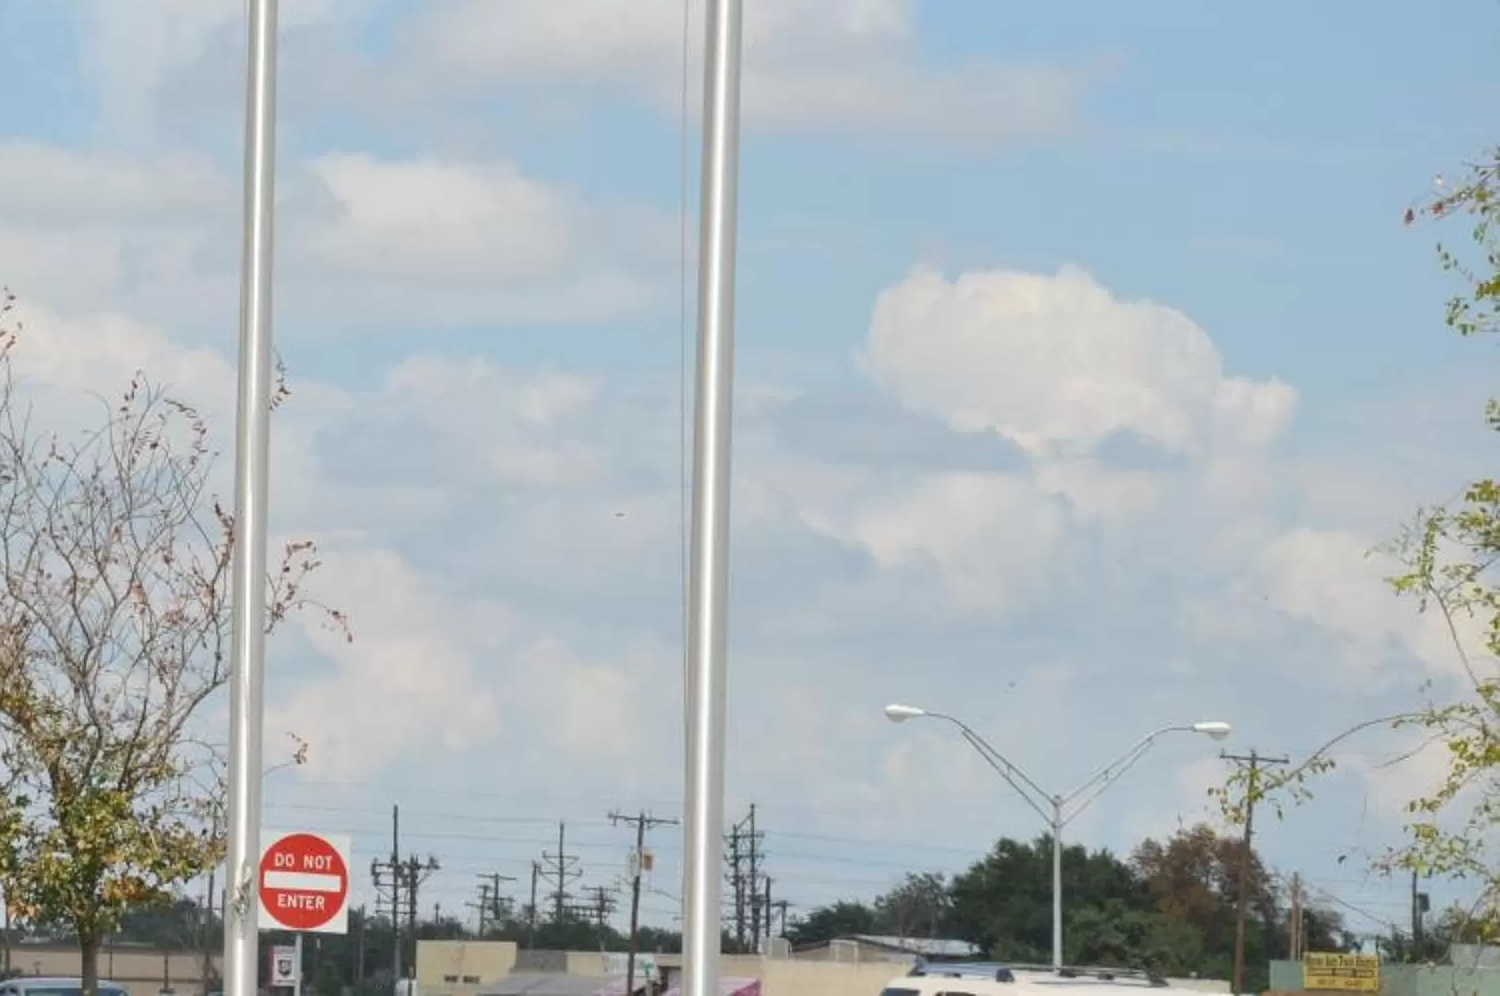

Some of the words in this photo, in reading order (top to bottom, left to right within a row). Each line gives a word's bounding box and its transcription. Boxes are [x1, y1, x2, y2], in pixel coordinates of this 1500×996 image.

[274, 852, 295, 868] DO
[303, 854, 333, 870] NOT
[277, 893, 326, 911] ENTER
